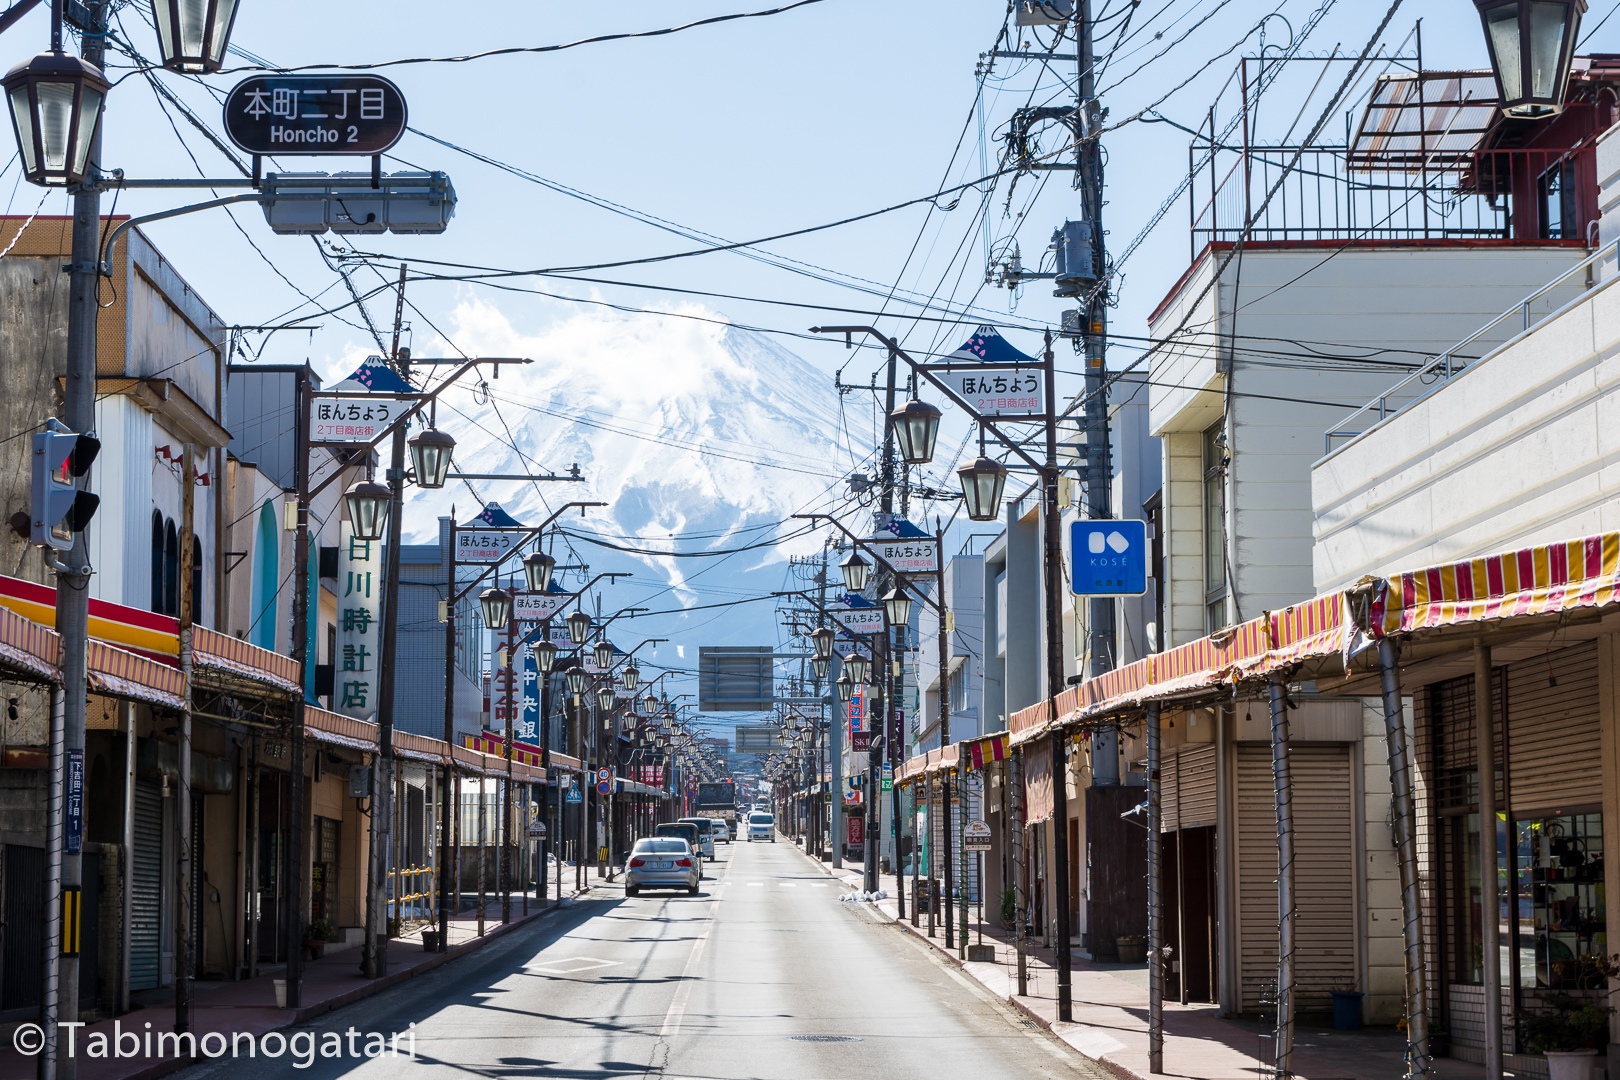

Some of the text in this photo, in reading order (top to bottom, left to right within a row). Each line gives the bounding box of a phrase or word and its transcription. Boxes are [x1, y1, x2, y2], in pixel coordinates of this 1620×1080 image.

[243, 87, 384, 121] 本町二丁目
[270, 125, 359, 143] Honcho 2
[962, 375, 1038, 394] ほんちょう
[977, 397, 1038, 409] 2丁目商店街
[317, 403, 390, 421] ほんちょう
[317, 424, 375, 436] 2丁目商店街
[460, 535, 510, 548] ほんちょう
[884, 545, 933, 558] ほんちょう
[1090, 556, 1127, 567] KOSÉ
[516, 598, 556, 609] ほんちょう
[844, 612, 882, 624] ほんちょう
